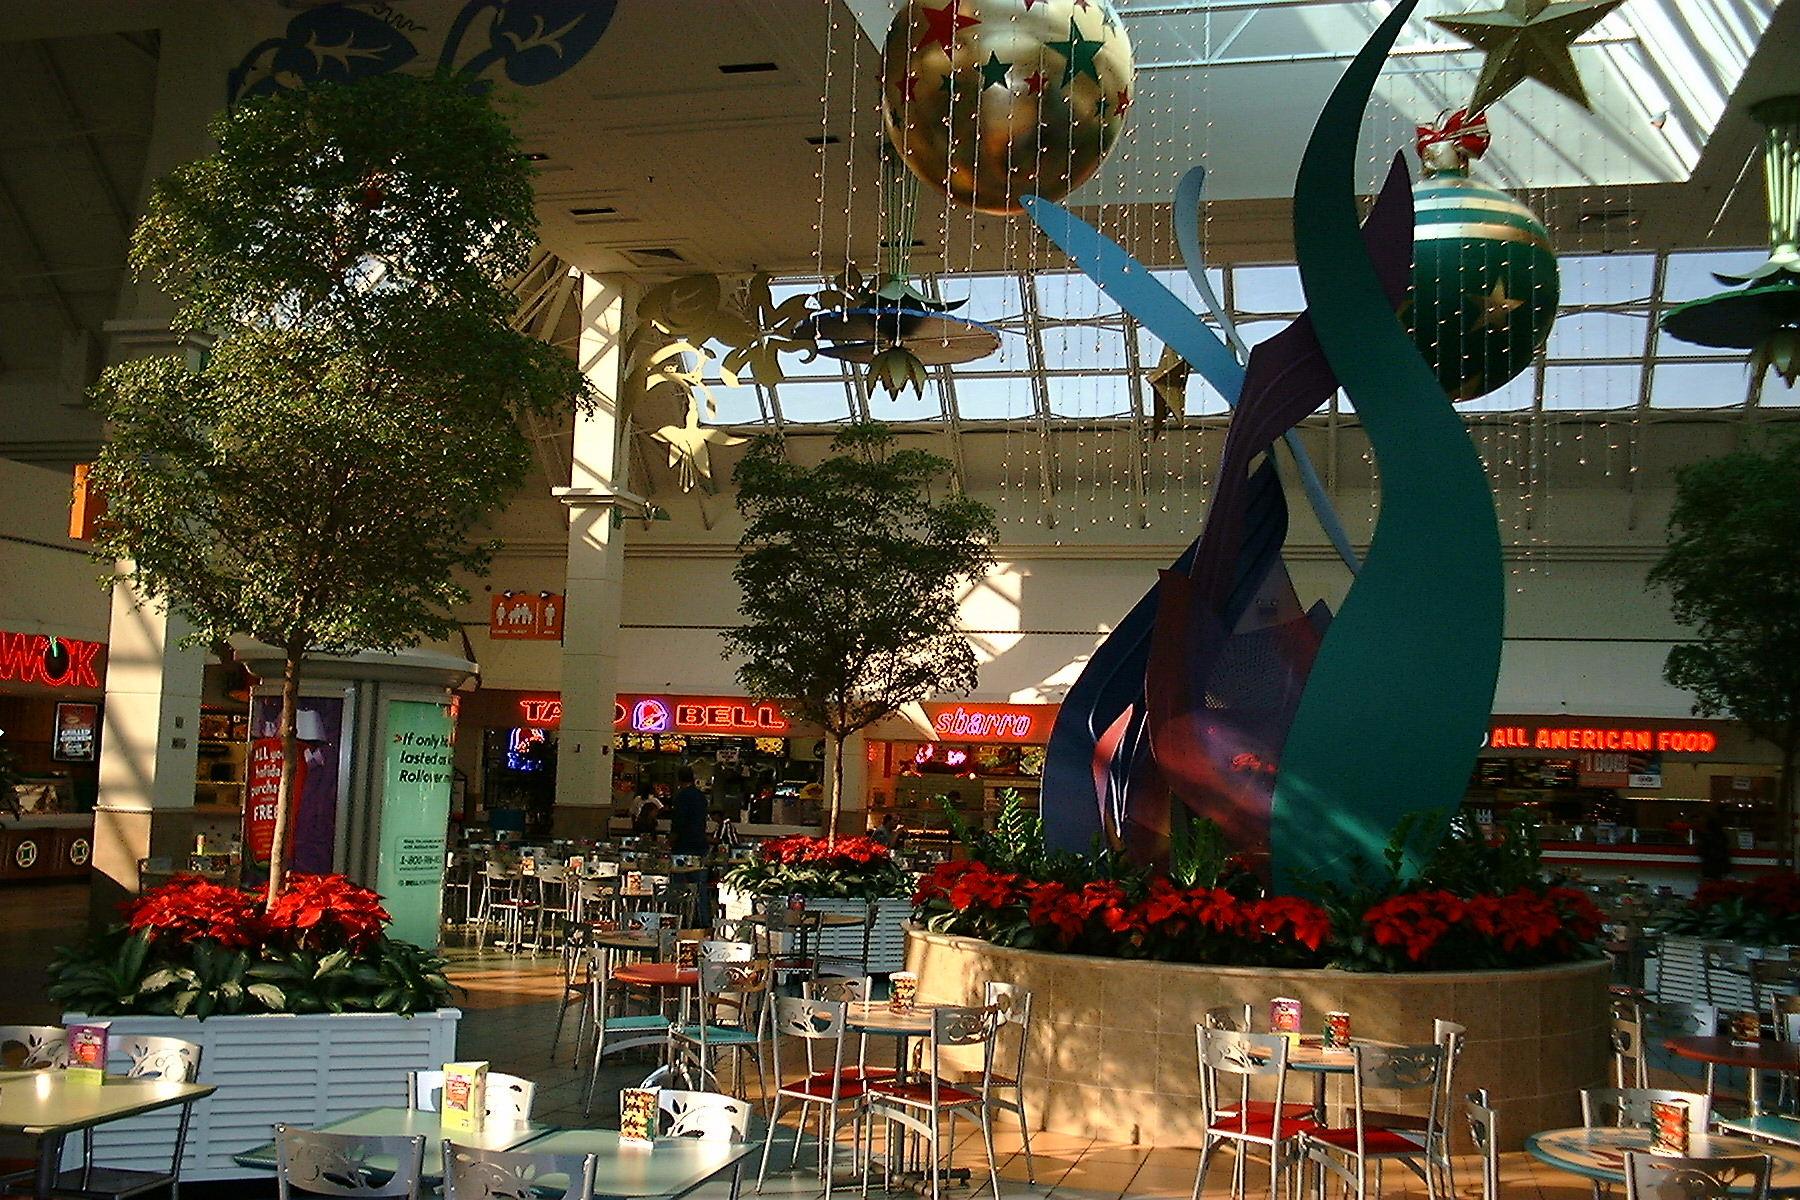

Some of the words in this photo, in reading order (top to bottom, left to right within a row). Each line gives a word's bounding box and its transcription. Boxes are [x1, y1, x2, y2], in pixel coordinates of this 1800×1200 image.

[0, 631, 100, 688] WOK
[676, 704, 785, 728] BELL
[935, 706, 1031, 737] sbarro
[403, 732, 414, 745] If
[416, 734, 440, 749] only
[1491, 727, 1530, 748] ALL
[1535, 728, 1651, 750] AMERICAN
[1657, 731, 1716, 752] FOOD
[254, 746, 268, 761] ALL
[400, 751, 438, 765] lasted
[255, 764, 281, 778] holida
